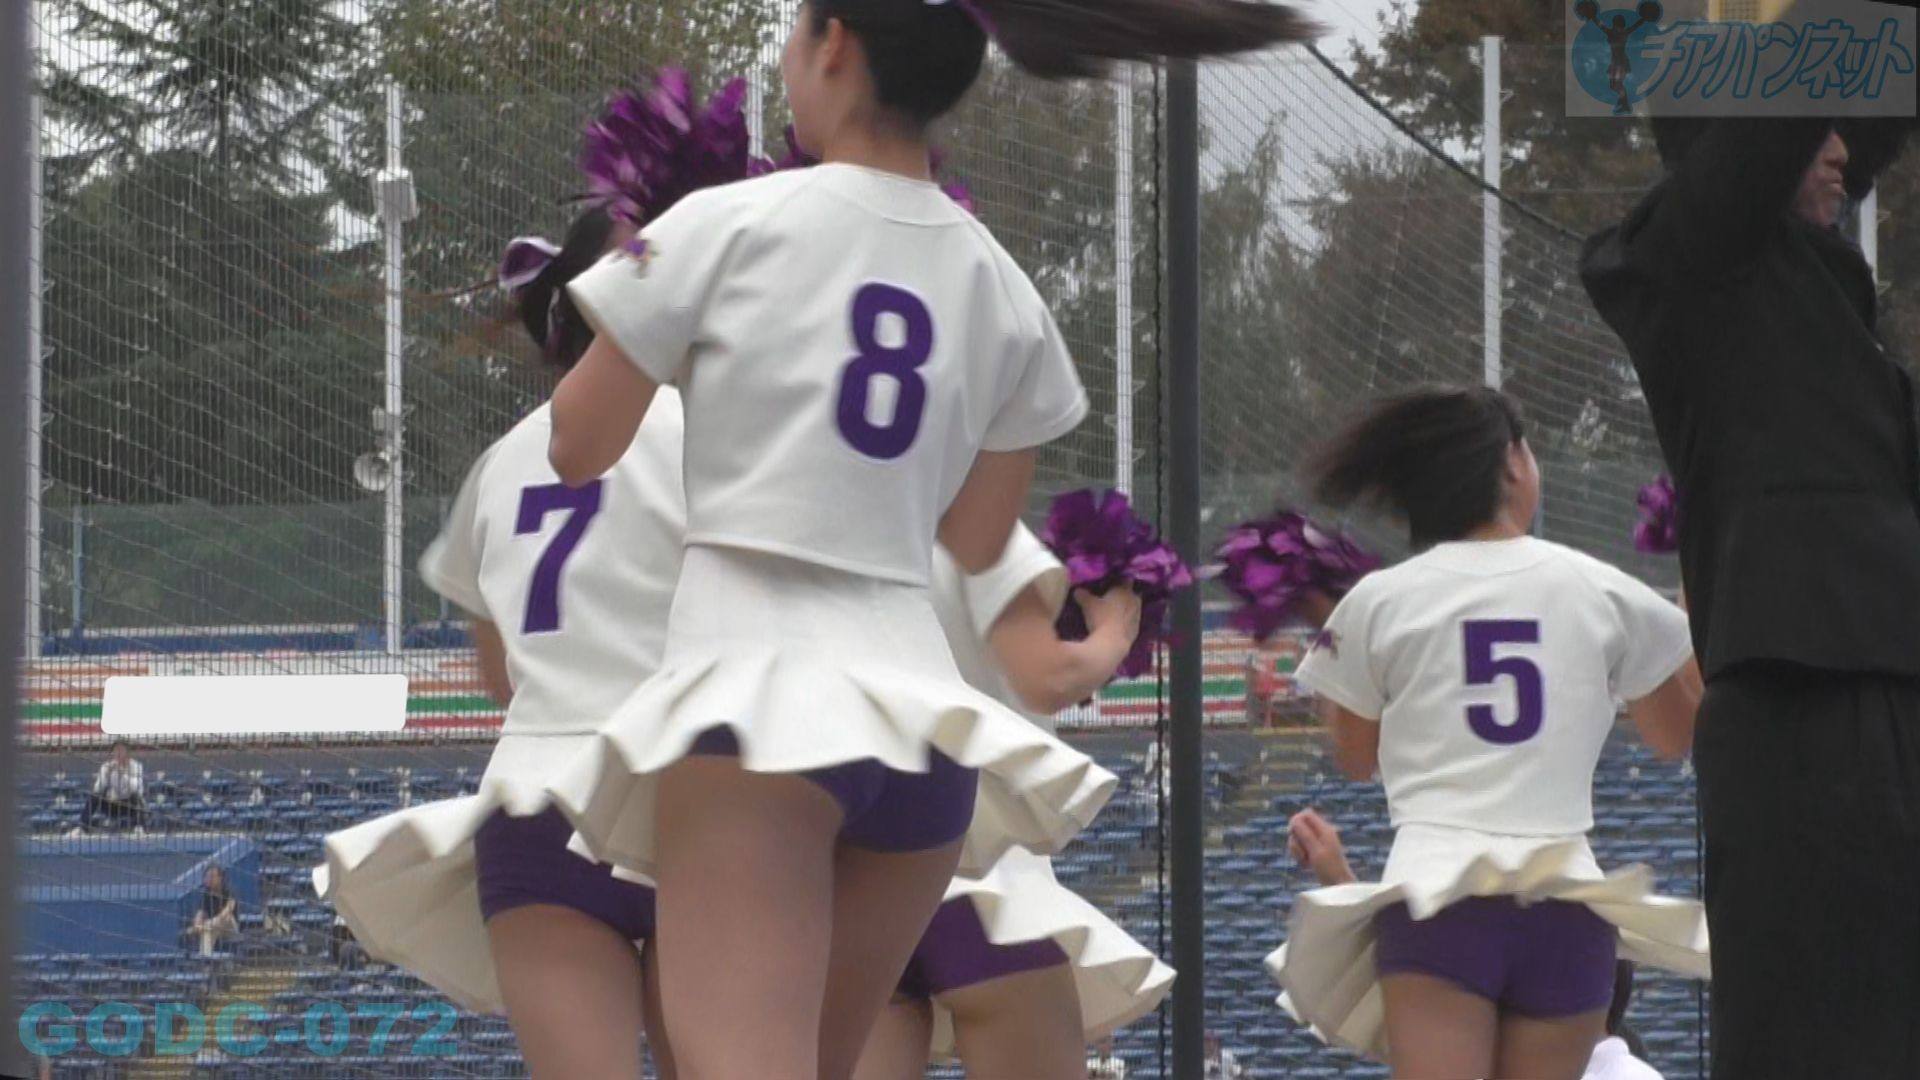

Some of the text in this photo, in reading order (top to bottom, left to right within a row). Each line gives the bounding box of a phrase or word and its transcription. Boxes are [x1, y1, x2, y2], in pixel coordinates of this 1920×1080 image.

[835, 283, 934, 461] 8
[513, 479, 604, 634] 7
[1462, 618, 1544, 745] 5
